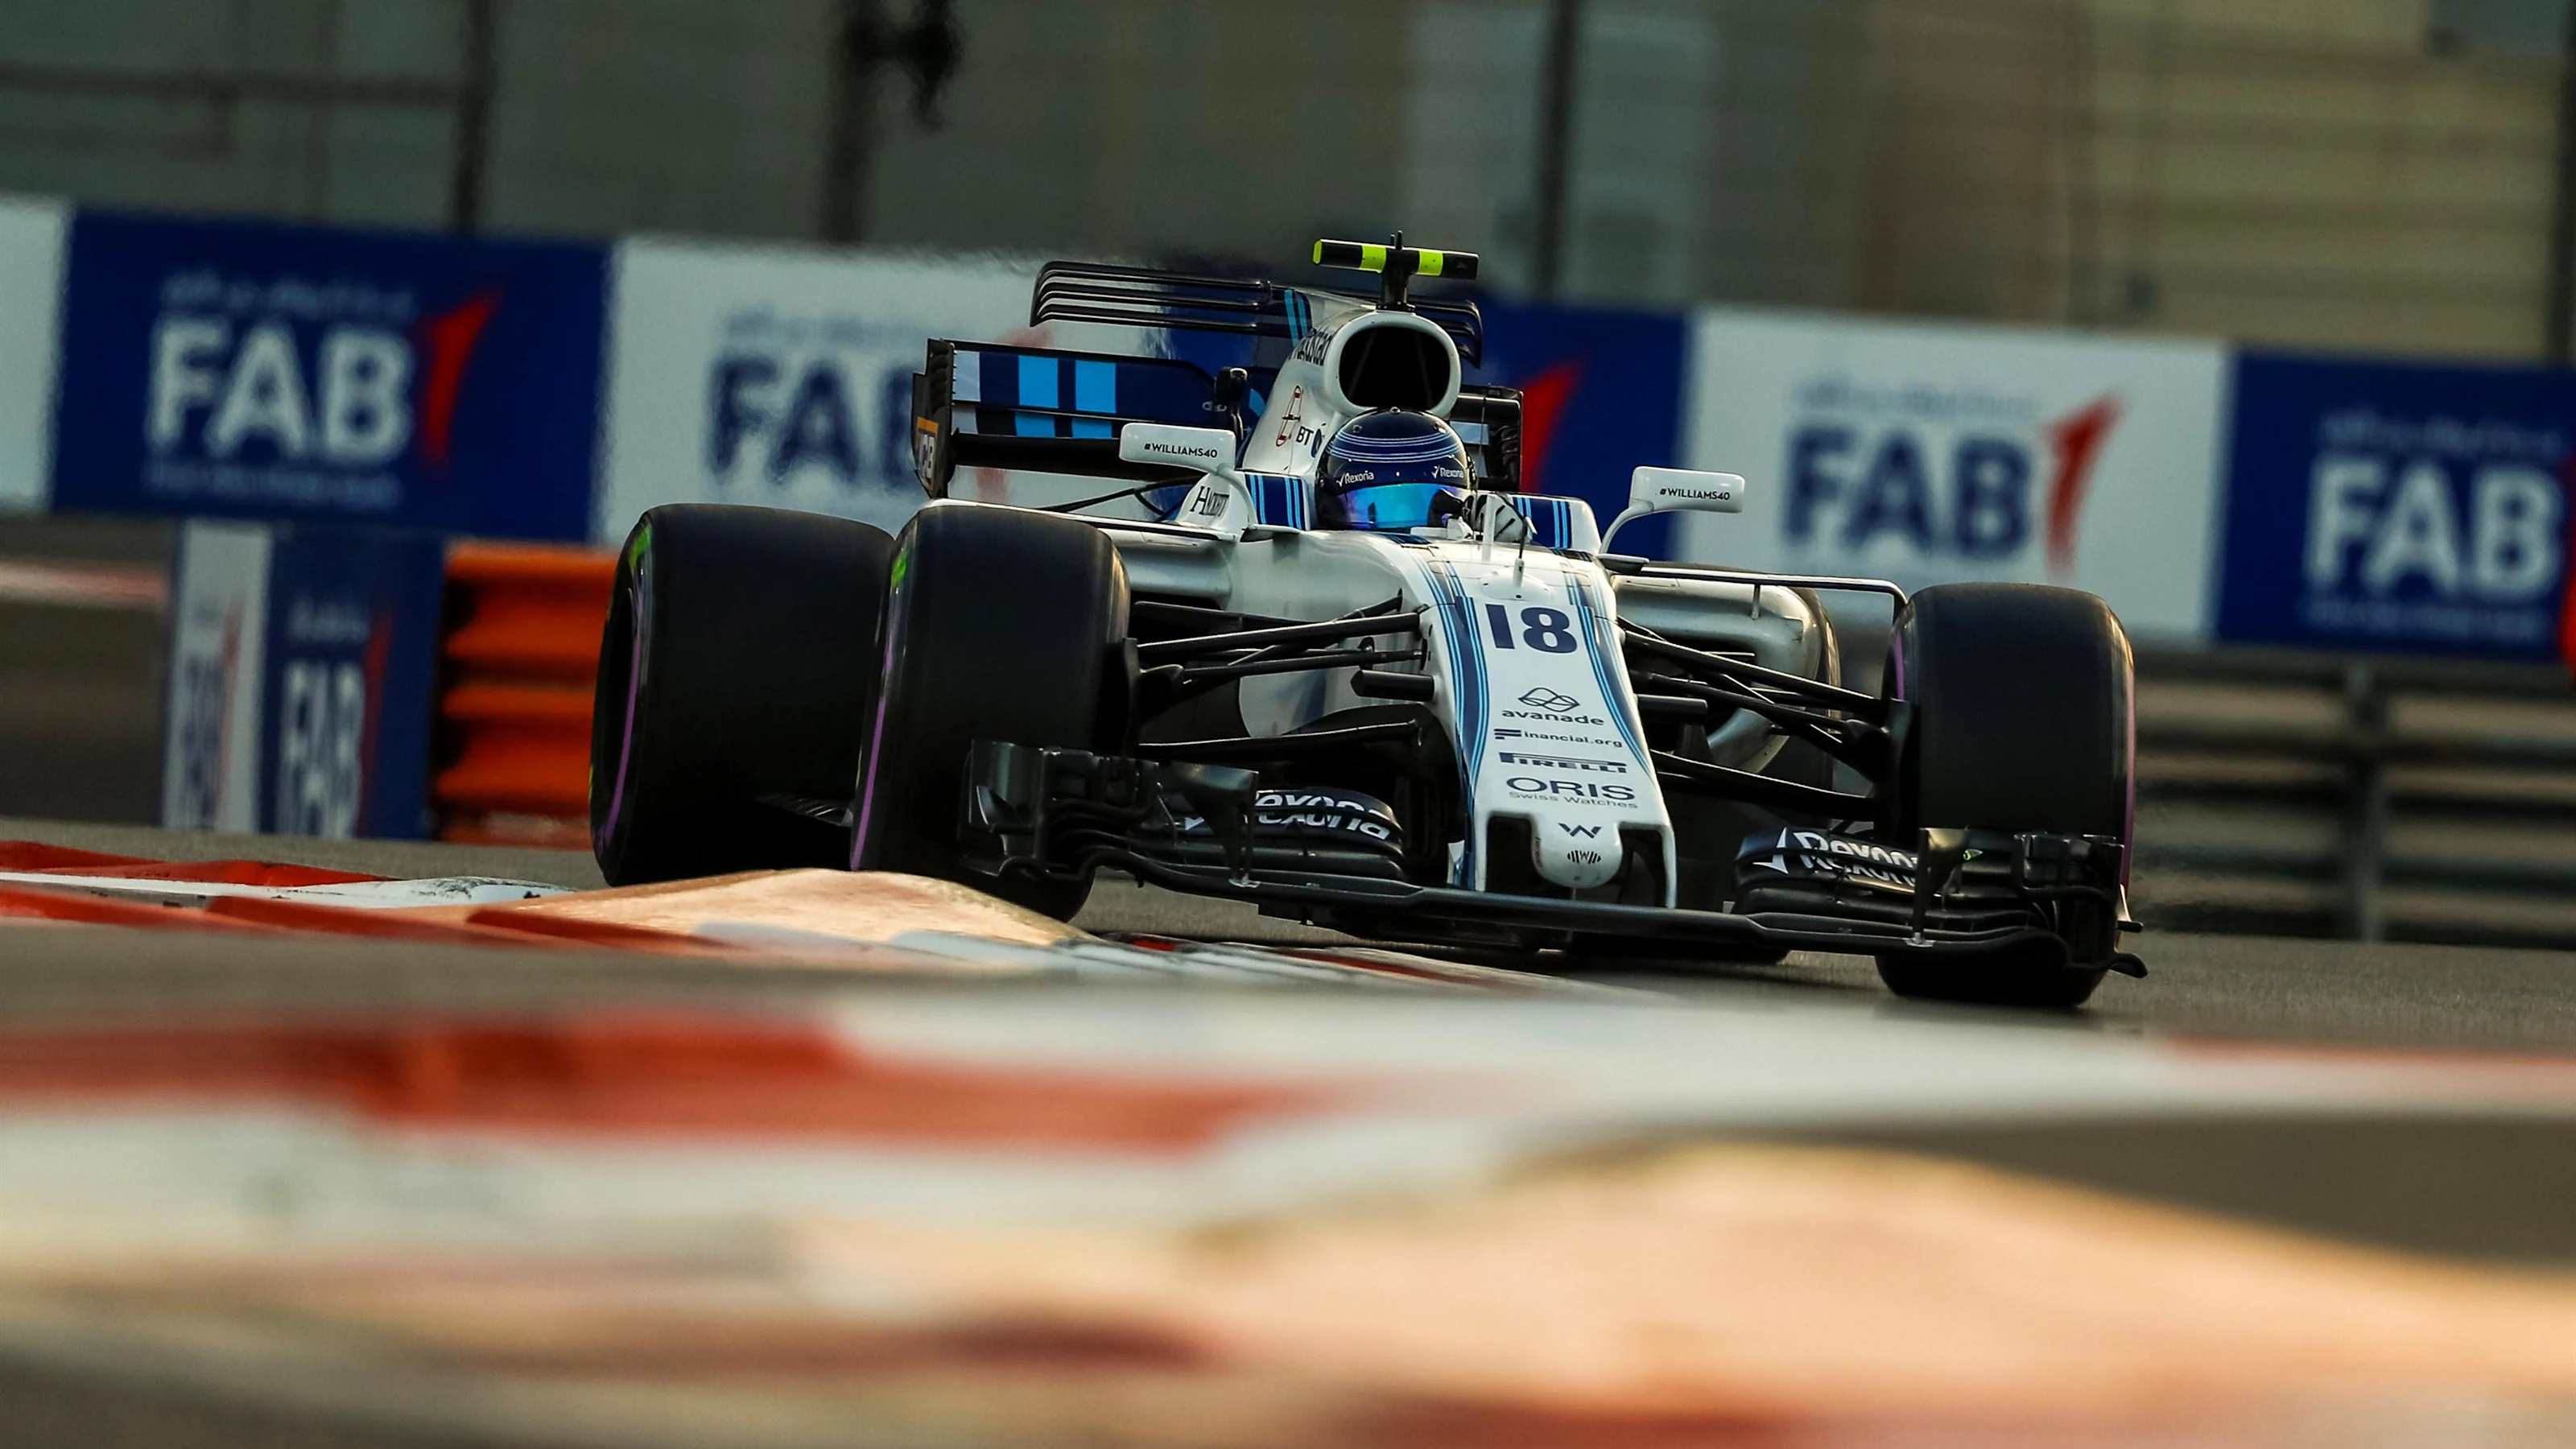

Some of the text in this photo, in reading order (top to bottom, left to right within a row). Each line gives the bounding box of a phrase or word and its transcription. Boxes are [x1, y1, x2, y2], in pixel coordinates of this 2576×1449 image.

[1295, 425, 1315, 446] BT
[1144, 443, 1218, 458] #WILLIAMS40
[1344, 470, 1374, 485] Rexona
[1440, 467, 1464, 479] Rexona
[1659, 488, 1730, 500] #WILLIAMS40
[1485, 604, 1578, 654] 18
[1502, 710, 1604, 725] avanade
[1499, 752, 1628, 774] PIRELLI
[1506, 777, 1636, 801] ORIS
[1509, 791, 1639, 809] Swiss Watches
